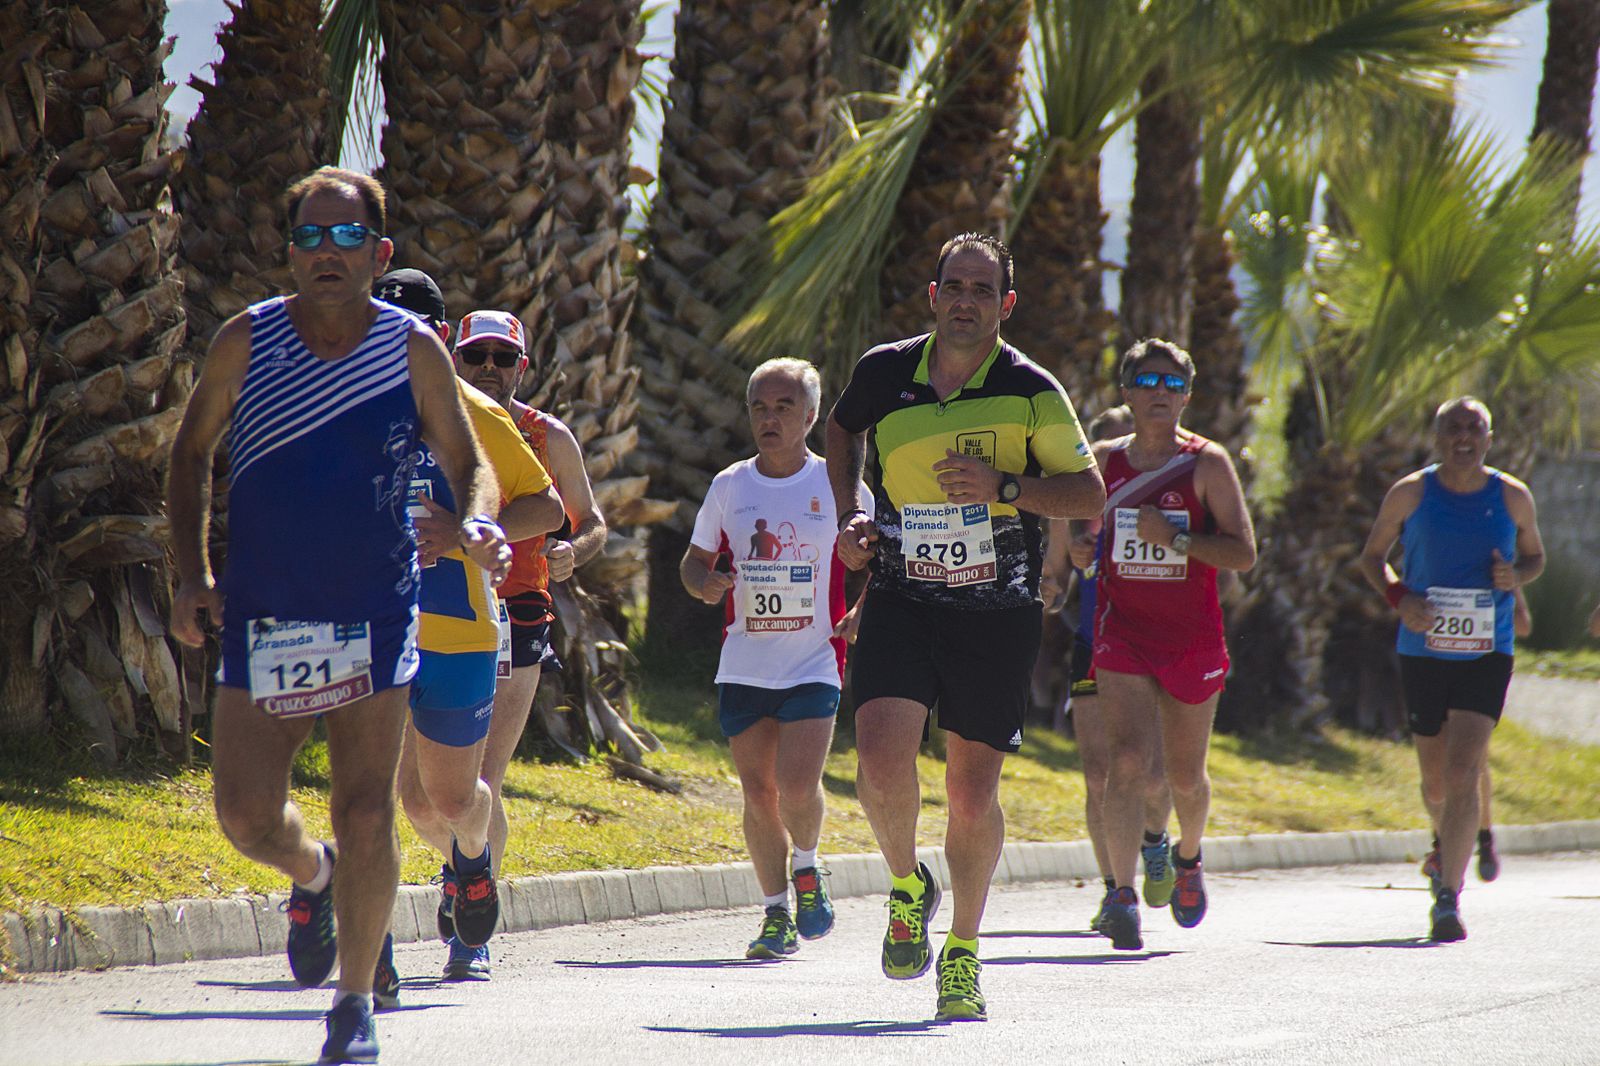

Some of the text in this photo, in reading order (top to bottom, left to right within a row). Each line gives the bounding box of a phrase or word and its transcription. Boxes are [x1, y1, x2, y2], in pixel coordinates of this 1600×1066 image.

[964, 439, 981, 447] VALLE
[972, 447, 984, 455] LOS
[965, 506, 984, 515] 2017
[905, 521, 949, 530] Granada
[929, 529, 970, 540] ANIVERSARIO
[916, 541, 968, 566] 879
[1124, 540, 1166, 561] 516
[755, 593, 782, 615] 30
[1433, 615, 1474, 636] 280
[254, 633, 314, 651] Granada
[269, 658, 332, 690] 121
[264, 684, 352, 714] Cruzcampo
